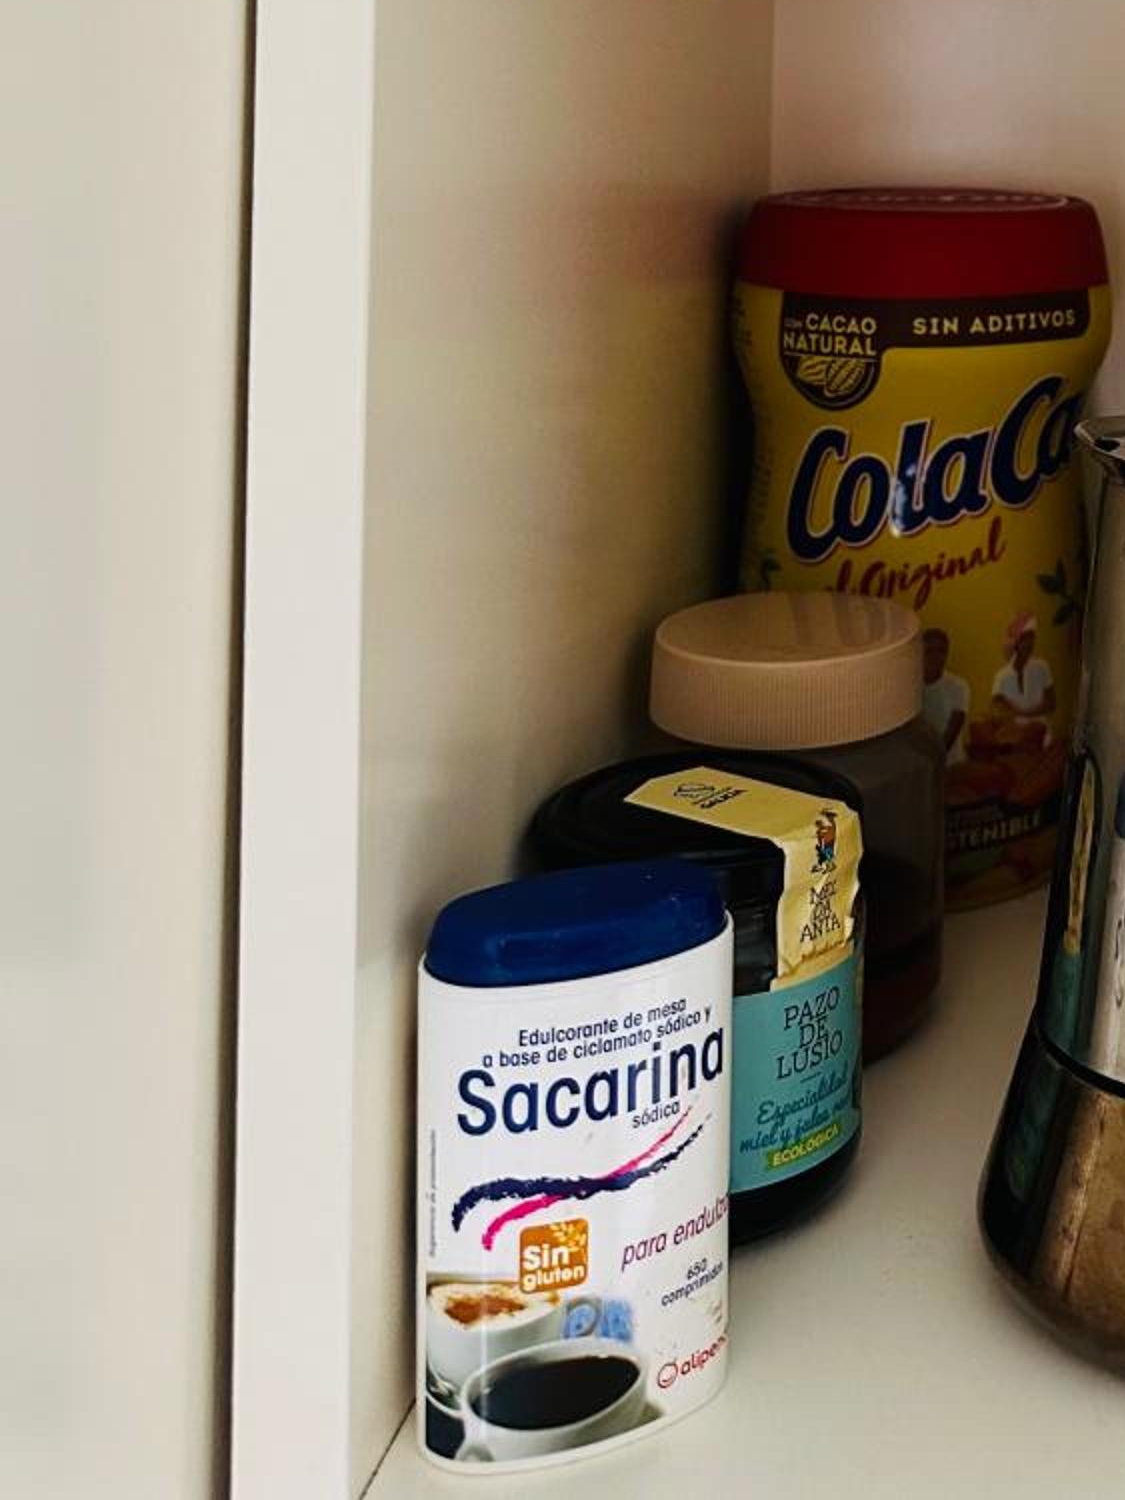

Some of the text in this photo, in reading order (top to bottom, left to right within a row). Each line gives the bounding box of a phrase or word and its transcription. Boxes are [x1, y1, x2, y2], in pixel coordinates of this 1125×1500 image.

[806, 312, 877, 334] CACAO
[912, 309, 1075, 335] SIN ADITIVOS
[783, 331, 877, 355] NATURAL
[519, 998, 686, 1047] Edulcorante de mesa
[784, 985, 840, 1031] PAZO
[482, 1006, 712, 1068] a base de ciclamato sódico y
[800, 1015, 829, 1048] DE
[776, 1030, 843, 1079] LUSIO
[457, 1027, 724, 1136] Sacarina
[632, 1099, 680, 1129] sódica
[523, 1243, 569, 1271] Sin
[621, 1232, 667, 1273] para
[523, 1265, 585, 1292] gluten
